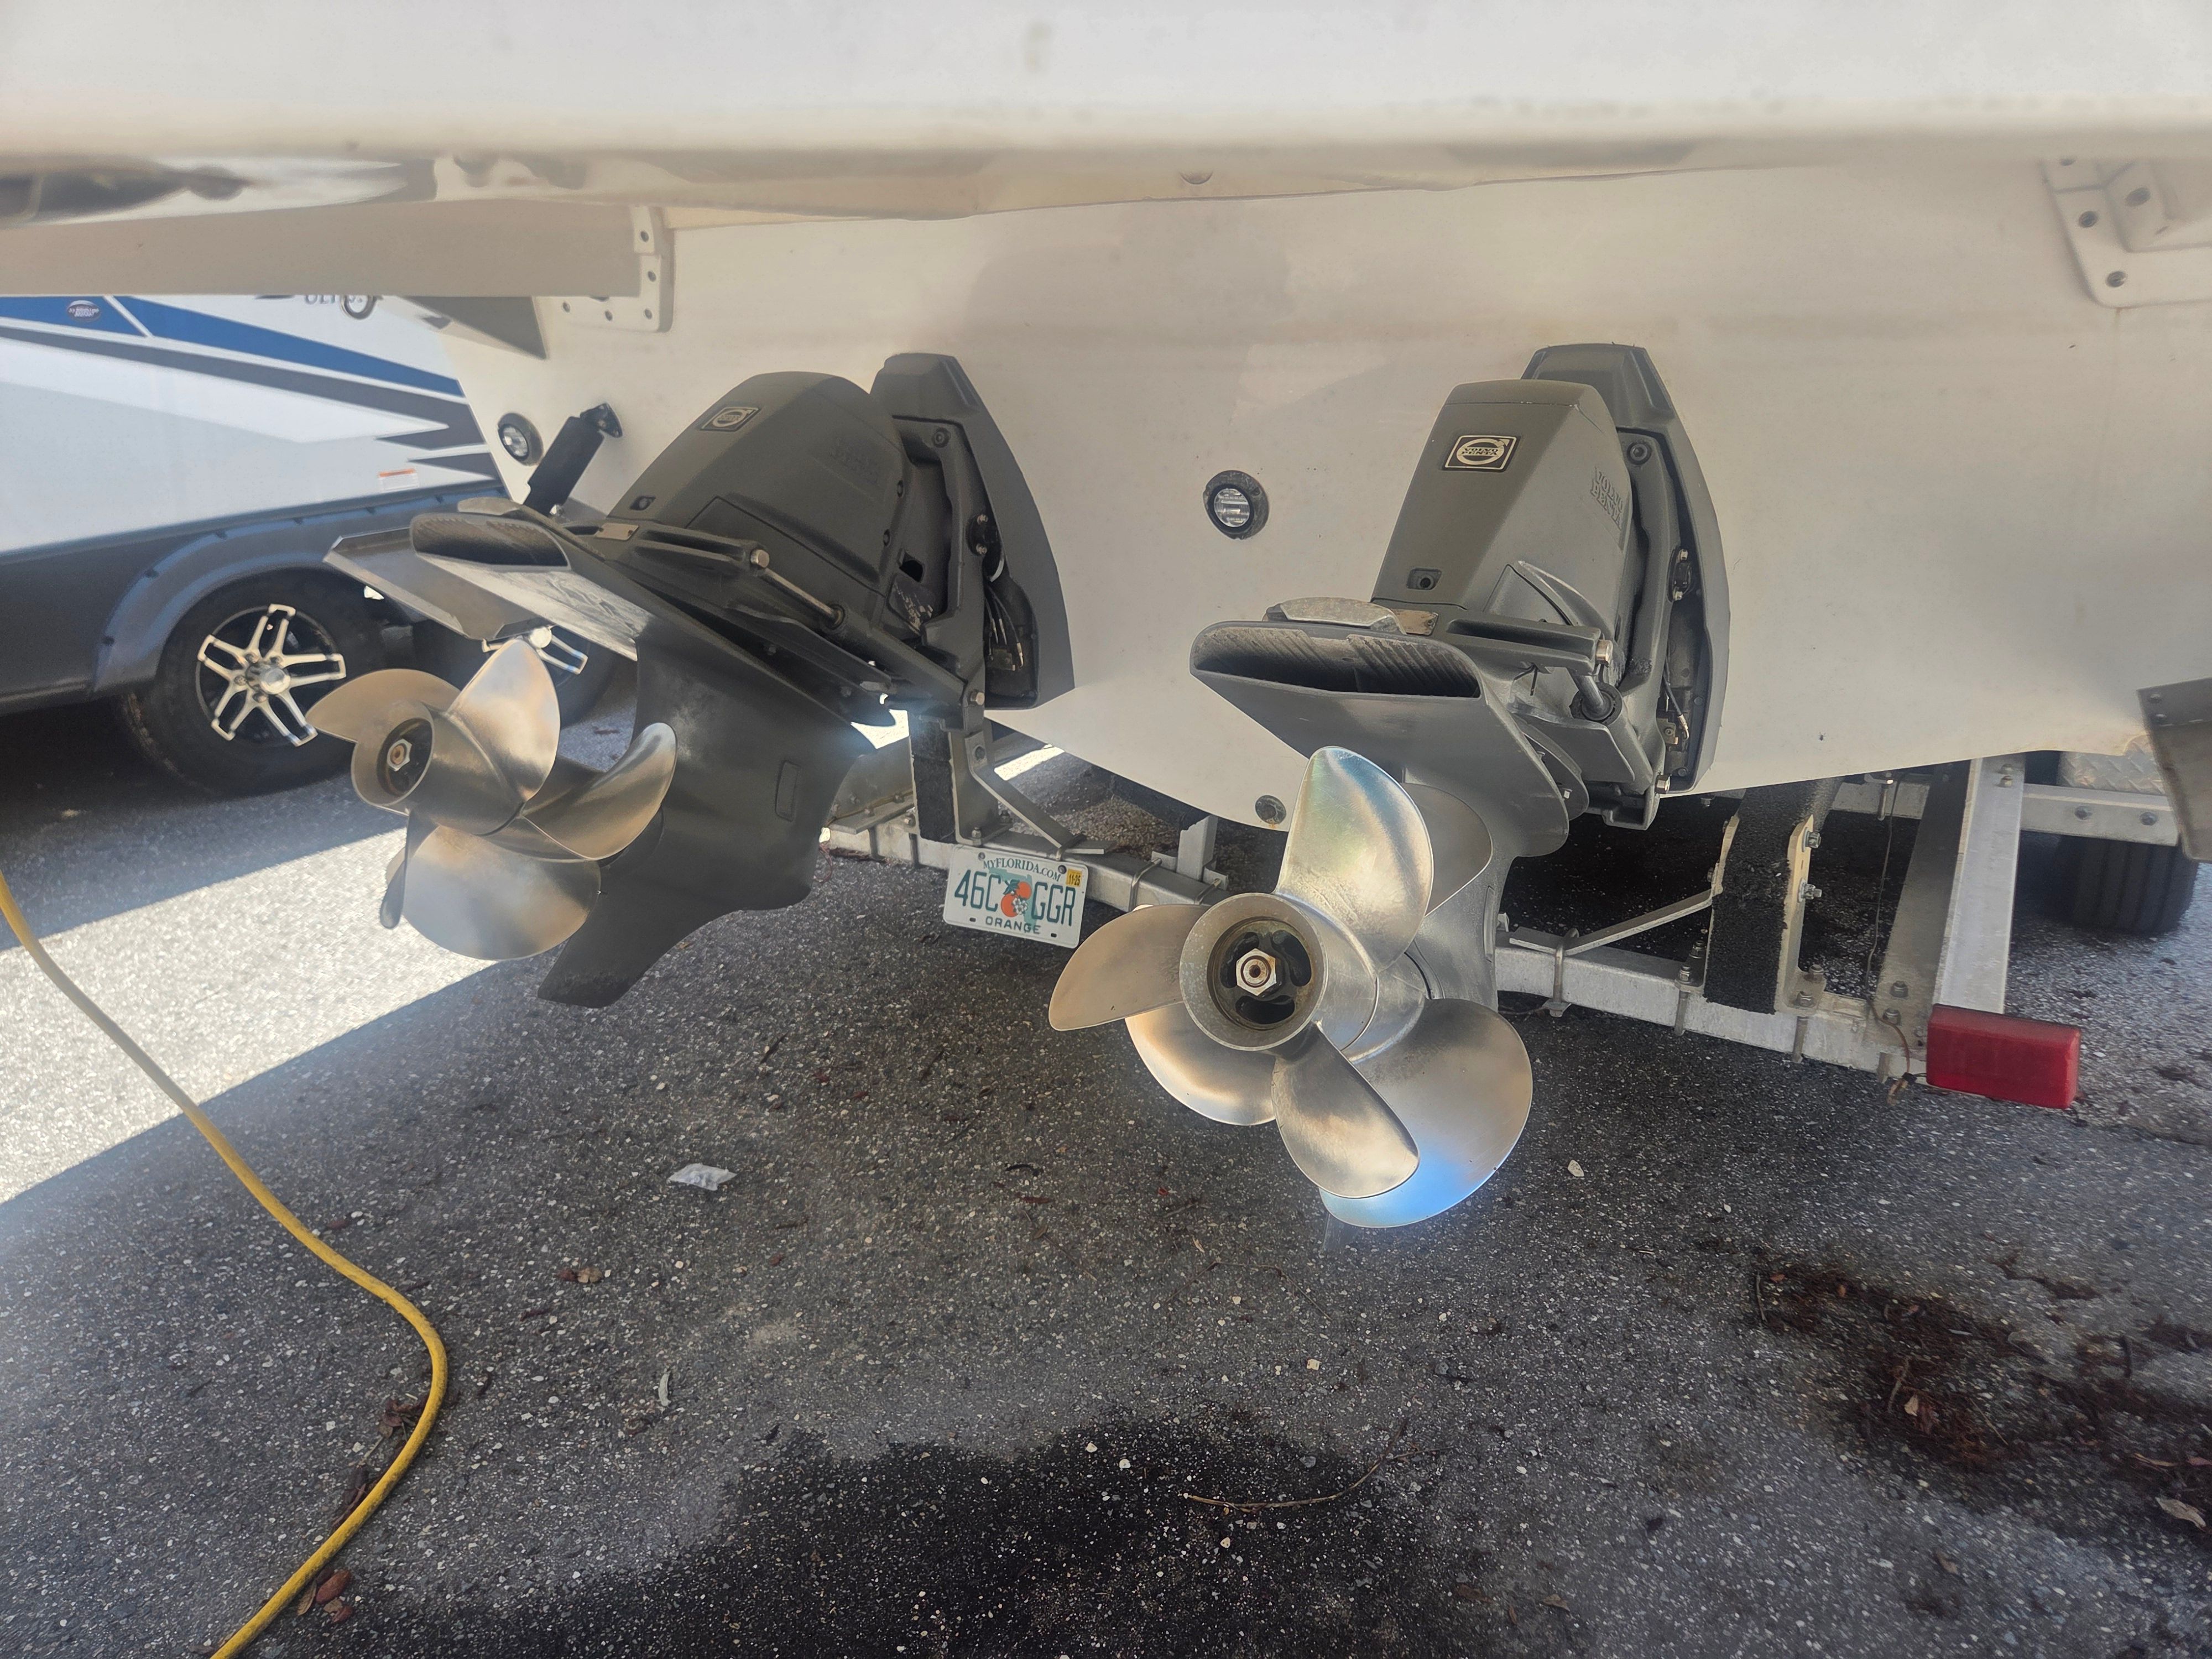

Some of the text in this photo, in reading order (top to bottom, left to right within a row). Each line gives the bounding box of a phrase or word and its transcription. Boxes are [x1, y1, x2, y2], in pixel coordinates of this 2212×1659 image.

[983, 858, 1061, 881] MYFLORIDA.COM
[954, 869, 1076, 926] 46C GGR
[985, 916, 1041, 935] ORANGE
